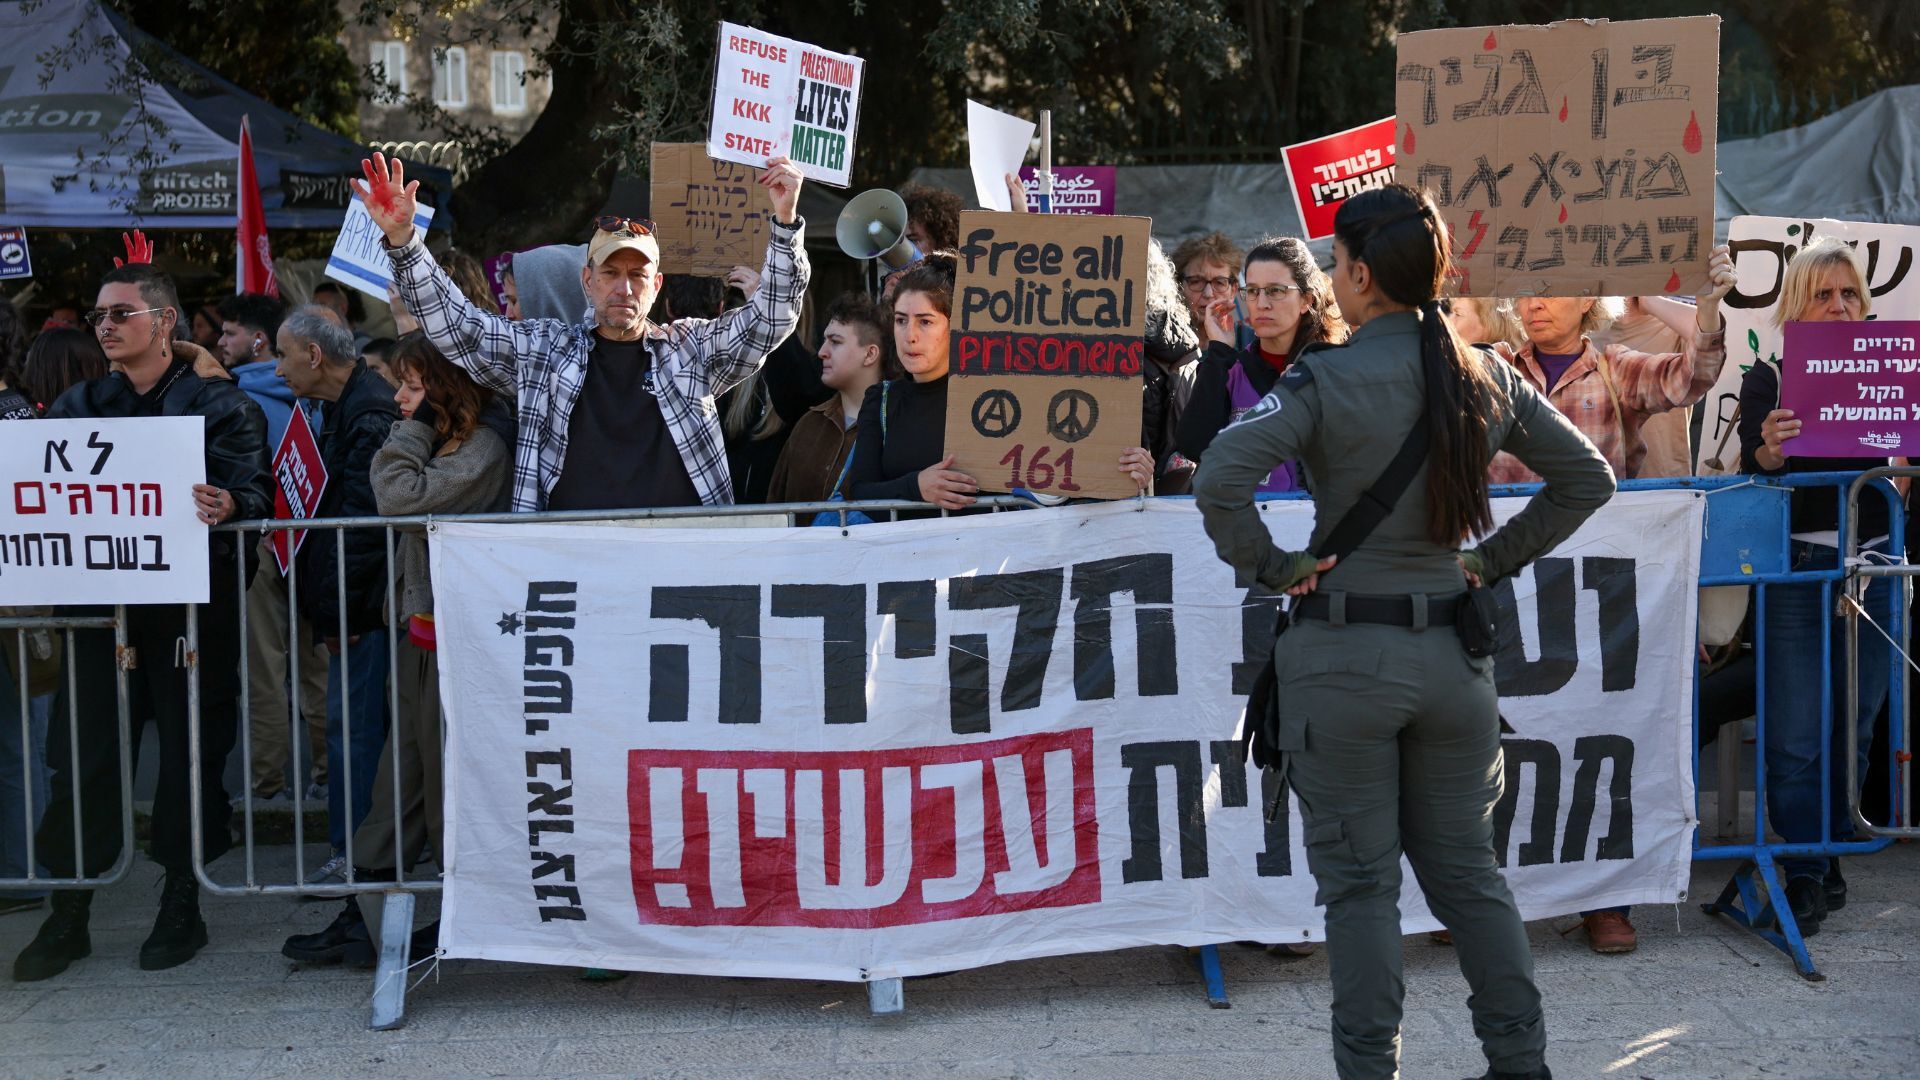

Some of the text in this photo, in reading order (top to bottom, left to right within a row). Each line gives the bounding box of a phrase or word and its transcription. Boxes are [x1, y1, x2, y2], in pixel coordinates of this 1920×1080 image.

[729, 35, 787, 63] REFUSE
[741, 68, 770, 89] THE
[800, 50, 854, 87] PALESTINIAN
[1397, 49, 1550, 126] גביר
[732, 97, 772, 123] KKK
[795, 78, 851, 132] LIVES
[724, 132, 772, 157] STATE
[789, 123, 846, 171] MATTER
[154, 171, 228, 190] HiTech
[1313, 148, 1382, 181] לטרור
[153, 193, 231, 209] PROTEST
[1051, 191, 1097, 204] ממשל
[959, 228, 1123, 281] free all
[958, 335, 1143, 374] prisoners
[1853, 337, 1915, 352] הידיים
[1806, 359, 1880, 374] הגבעות
[1857, 382, 1904, 404] הקול
[1819, 403, 1907, 421] הממשלה
[44, 431, 114, 475] לא
[1000, 444, 1081, 492] 161
[13, 481, 162, 517] הורגים
[85, 534, 171, 571] בשם
[647, 552, 1178, 734] חקירה
[647, 747, 1077, 910] עכשיו!
